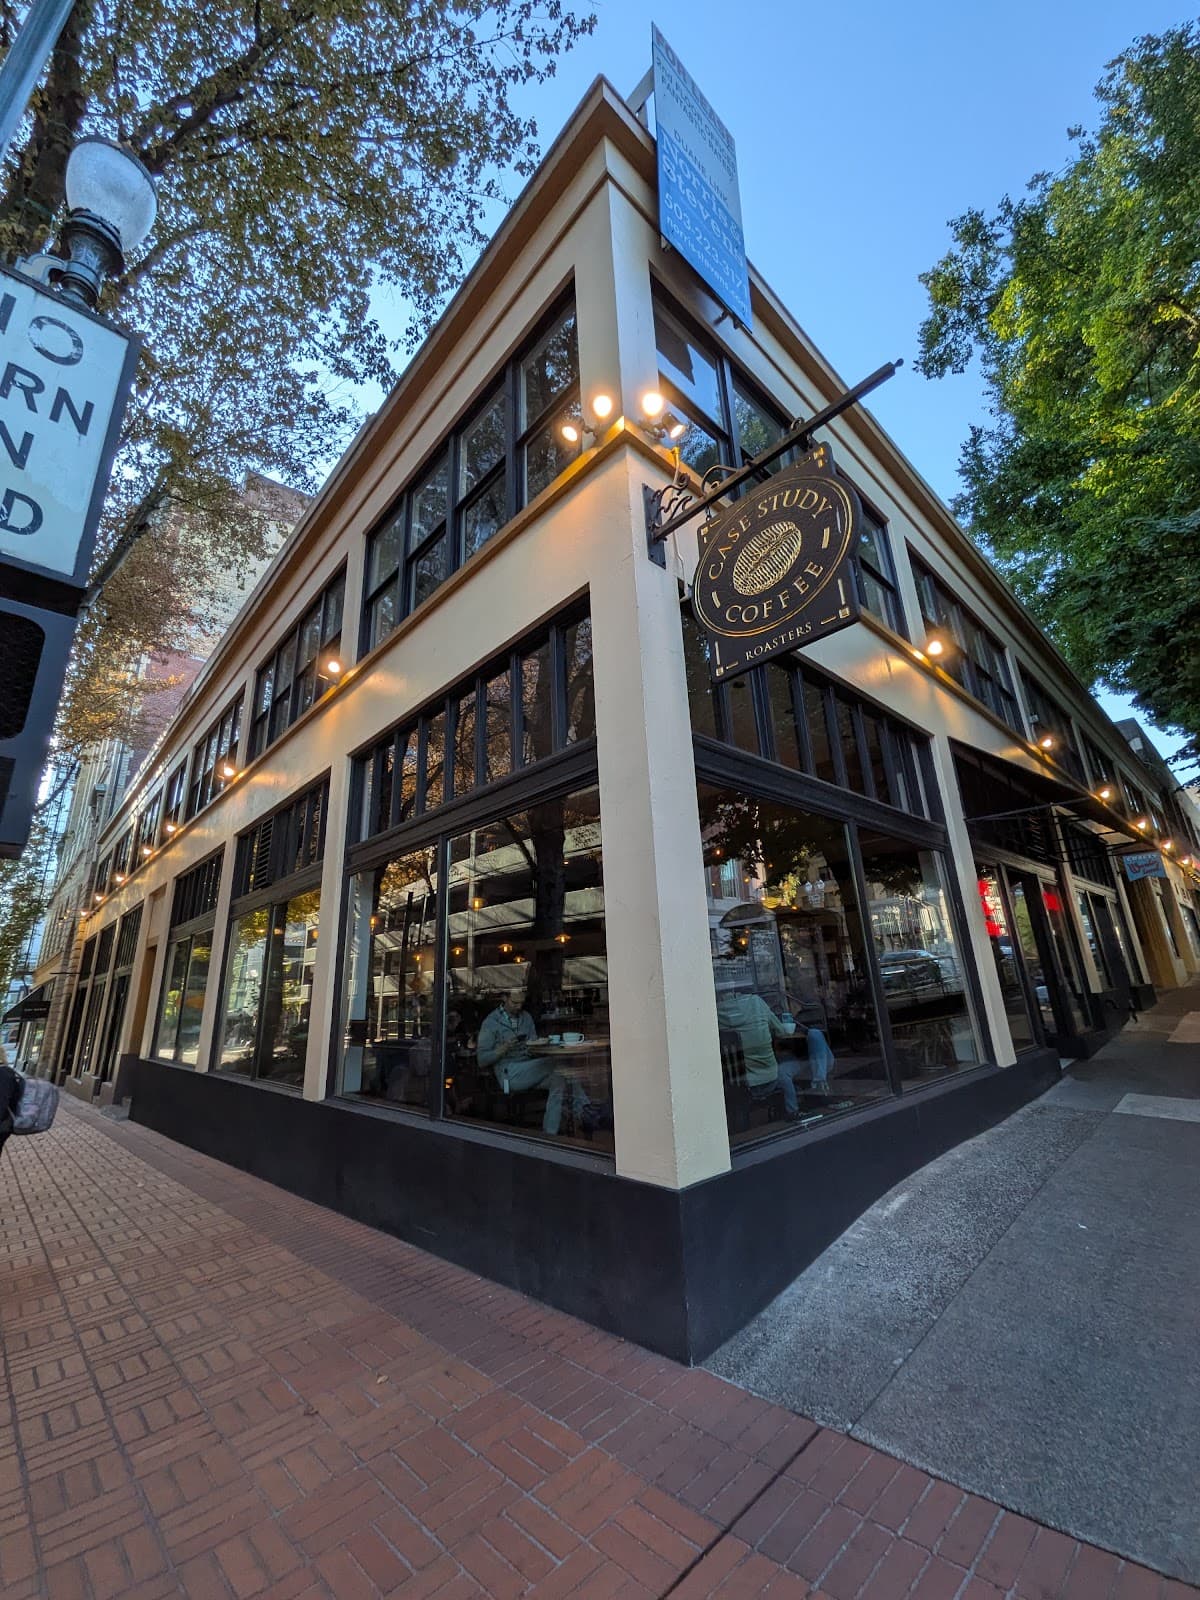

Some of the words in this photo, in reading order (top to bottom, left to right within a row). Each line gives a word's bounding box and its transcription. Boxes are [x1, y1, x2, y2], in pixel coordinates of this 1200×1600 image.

[655, 27, 686, 85] FOR
[690, 78, 735, 156] LEASE
[661, 149, 743, 269] Stevens
[662, 128, 728, 230] Norris
[730, 218, 741, 245] &
[664, 191, 747, 300] 503-223-3171
[708, 514, 752, 581] CASE
[757, 488, 834, 520] STUDY
[724, 560, 824, 624] COFFEE
[744, 621, 813, 662] ROASTERS
